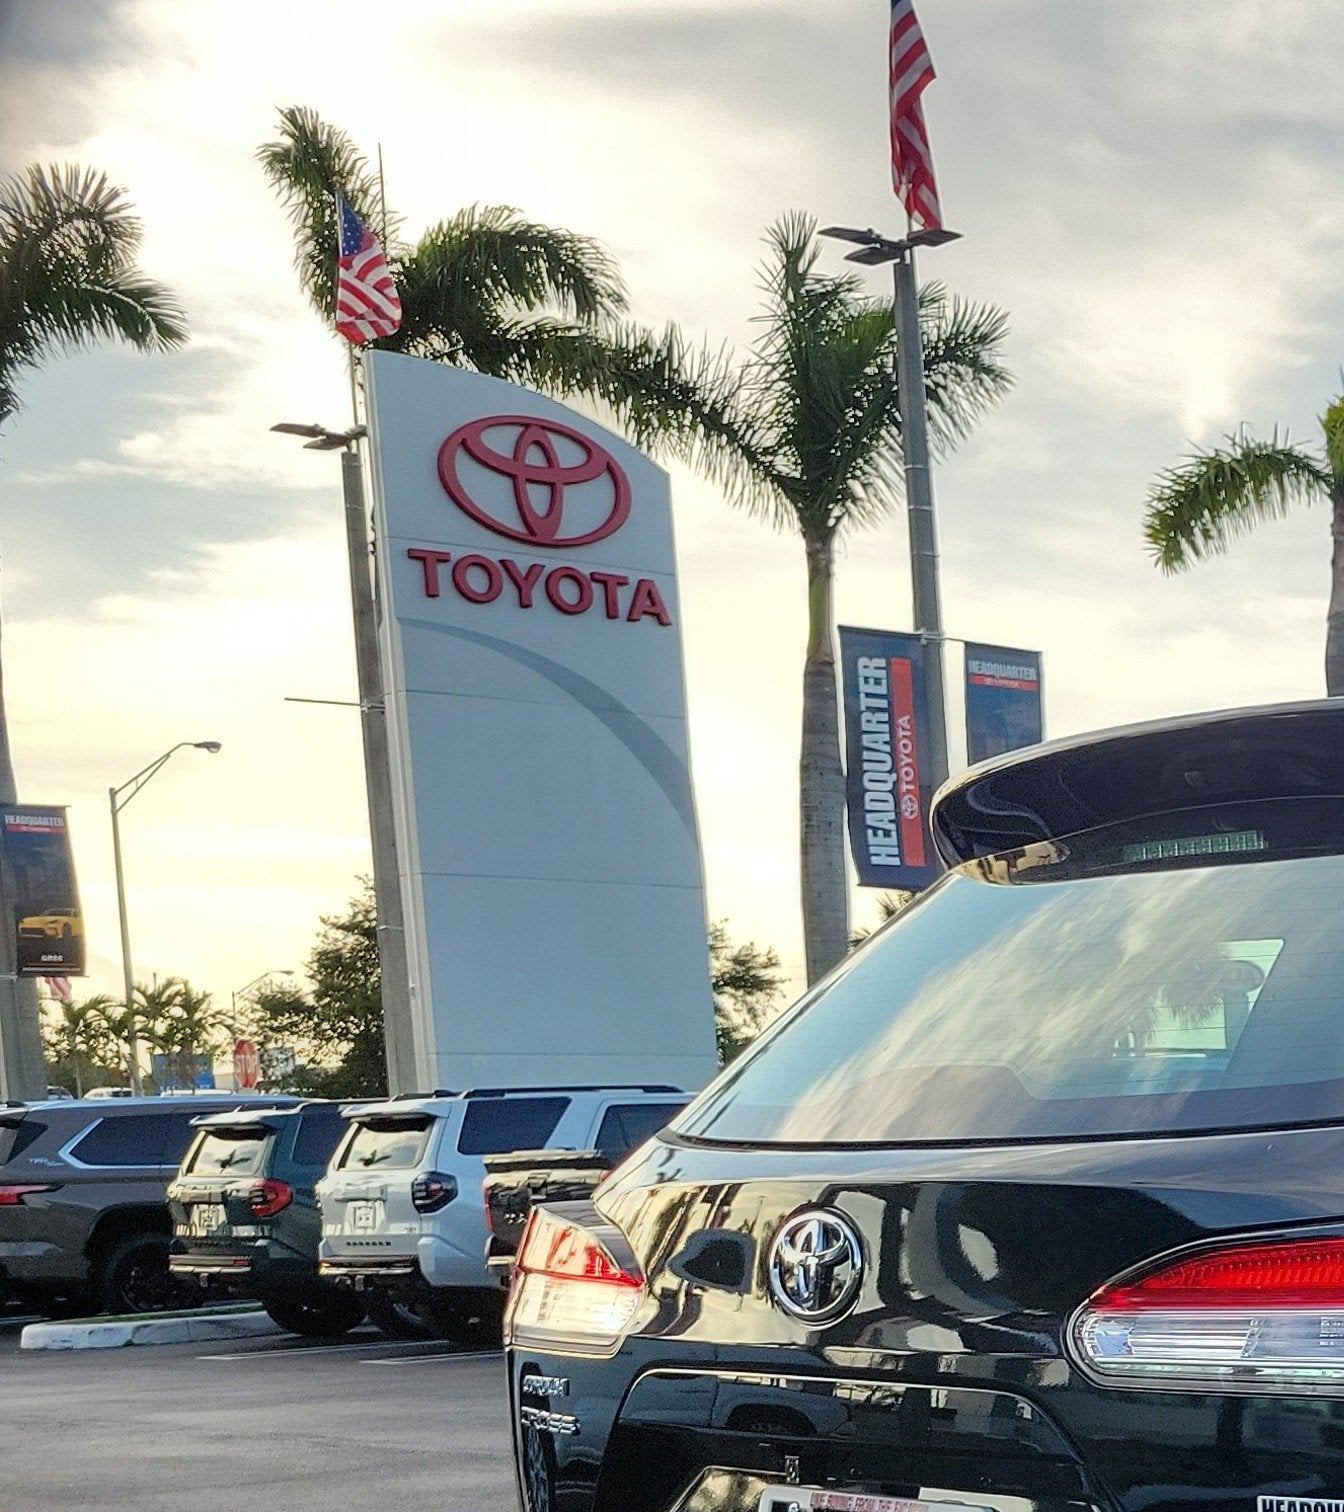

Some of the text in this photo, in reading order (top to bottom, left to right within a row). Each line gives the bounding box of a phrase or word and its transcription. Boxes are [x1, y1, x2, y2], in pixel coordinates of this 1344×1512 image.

[407, 547, 672, 626] TOYOTA
[857, 656, 901, 867] HEADQUARTER
[898, 715, 917, 794] TOYOTA
[234, 1053, 260, 1074] STOP
